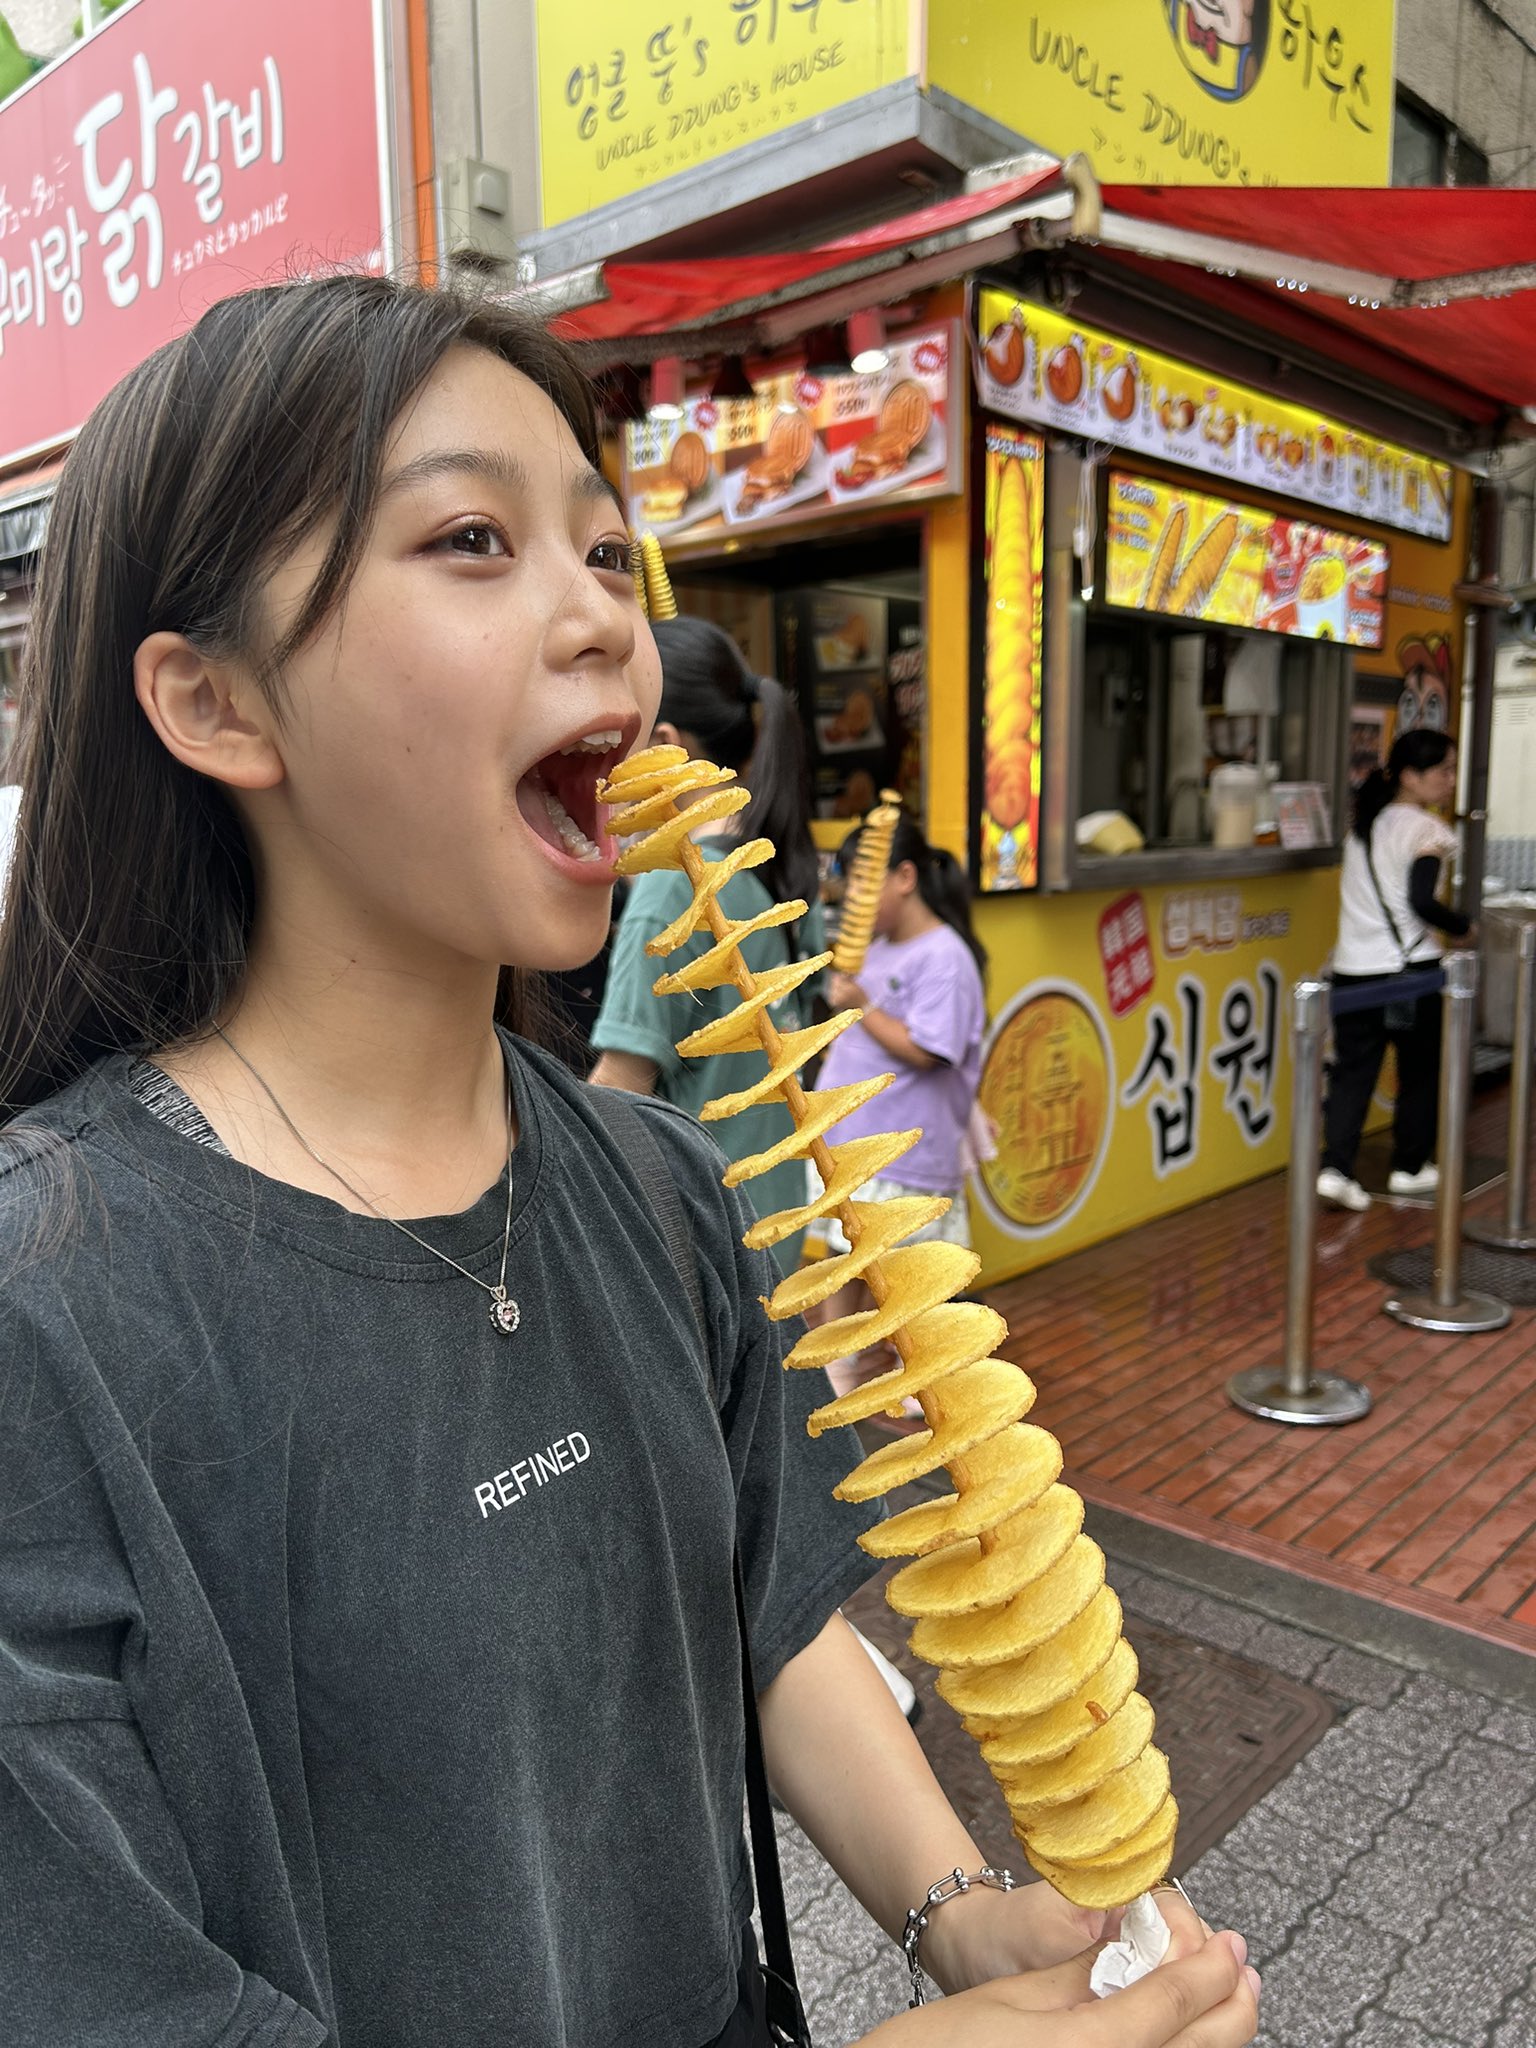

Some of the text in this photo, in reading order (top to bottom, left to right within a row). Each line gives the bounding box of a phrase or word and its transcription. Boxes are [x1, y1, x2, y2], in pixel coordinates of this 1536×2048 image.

[596, 124, 659, 172] UNCLE
[770, 39, 848, 95] HOUSE
[1029, 15, 1126, 113] UNCLE
[1124, 966, 1278, 1168] 십원
[474, 1431, 591, 1519] REFINED
